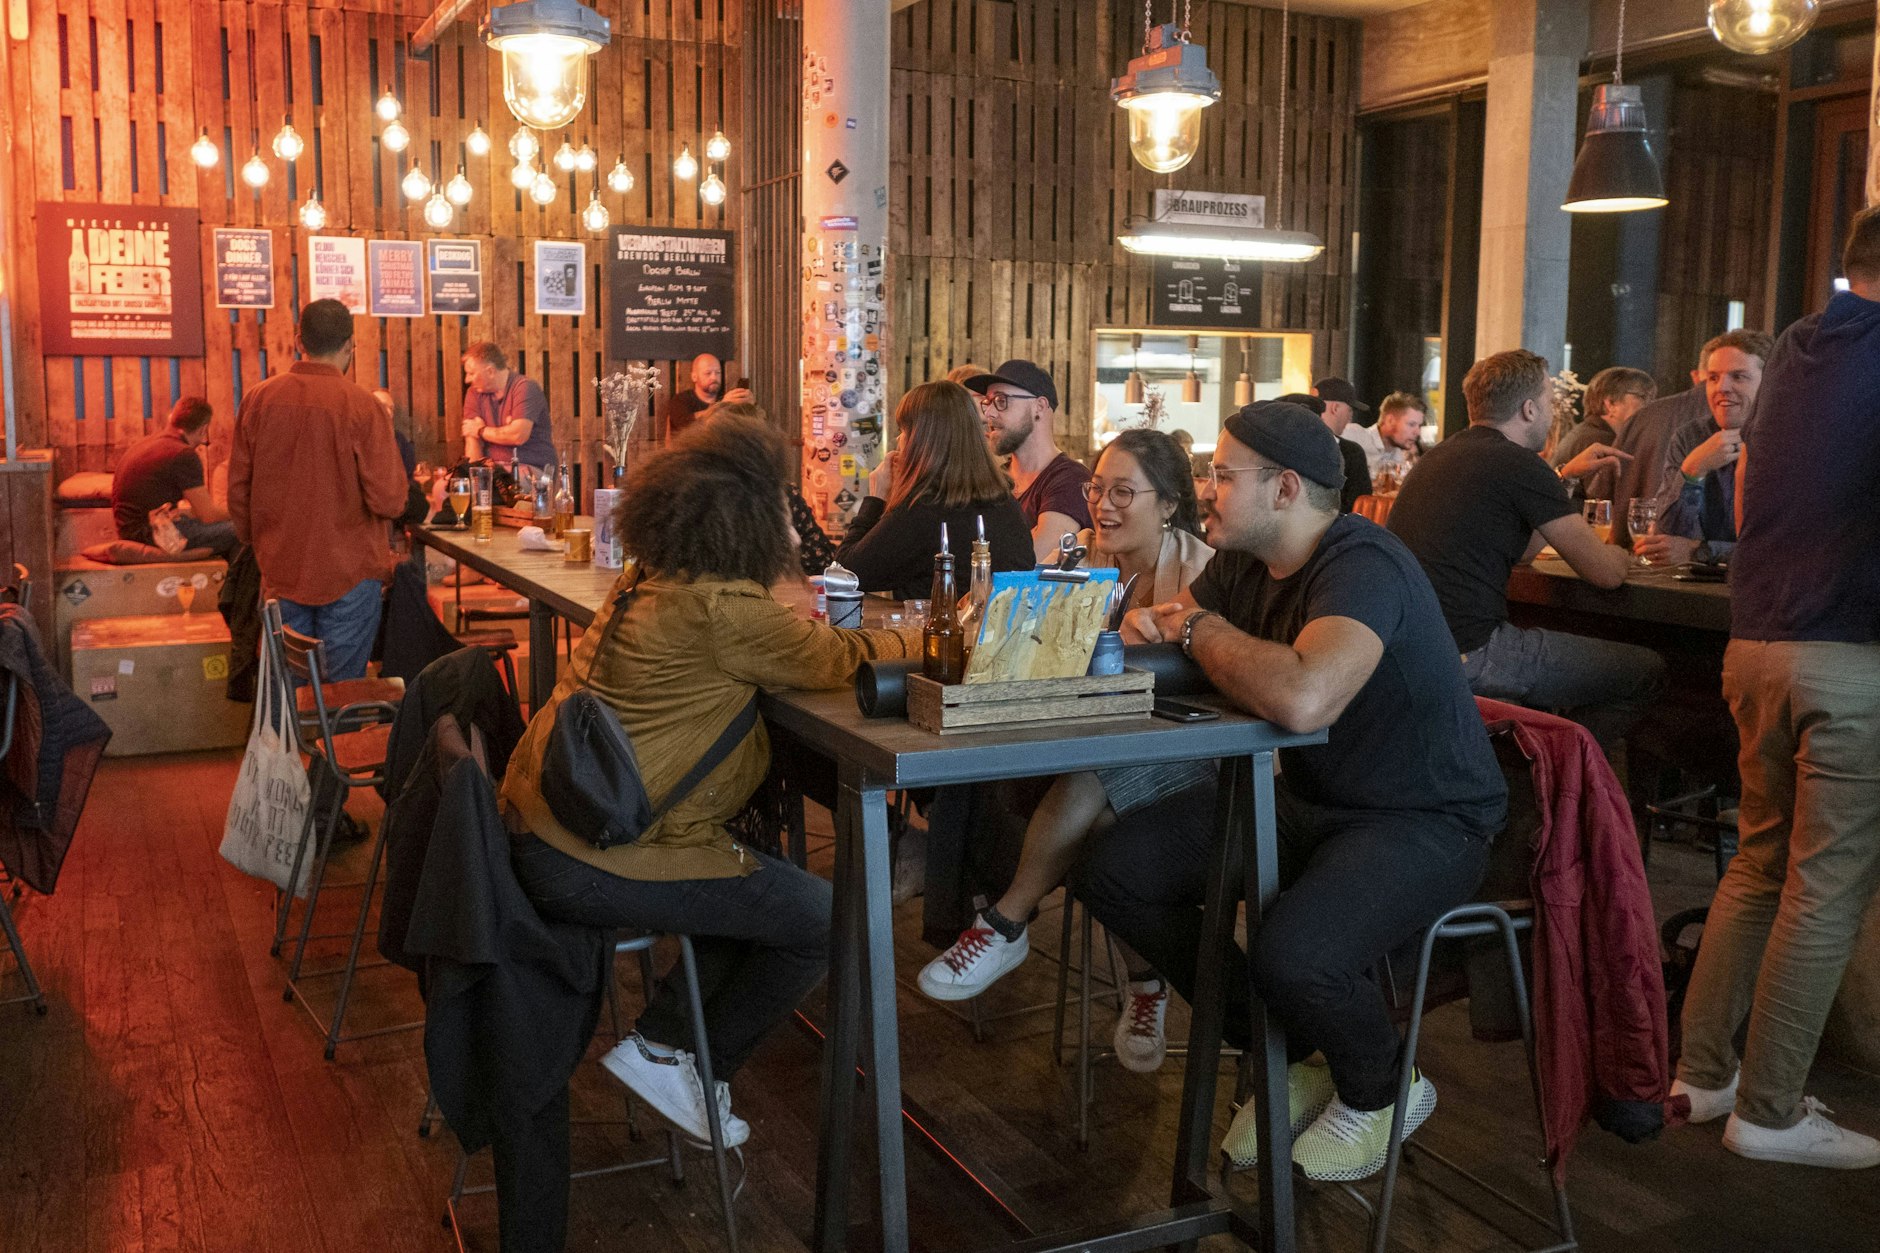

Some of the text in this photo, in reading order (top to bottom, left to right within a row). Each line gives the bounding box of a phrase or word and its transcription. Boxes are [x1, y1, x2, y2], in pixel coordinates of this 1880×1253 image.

[1173, 200, 1248, 216] BRAUPROZESS
[66, 218, 169, 231] MIETE UNS
[88, 228, 170, 266] DEINE
[230, 238, 257, 251] DOGS
[618, 234, 726, 254] VERANSTALTUNGEN
[225, 251, 262, 263] DINNER
[379, 249, 414, 262] MERRY
[618, 250, 726, 264] BREWDOG BERLIN MITTE
[90, 265, 172, 295] FEIER
[380, 279, 415, 289] ANIMALS
